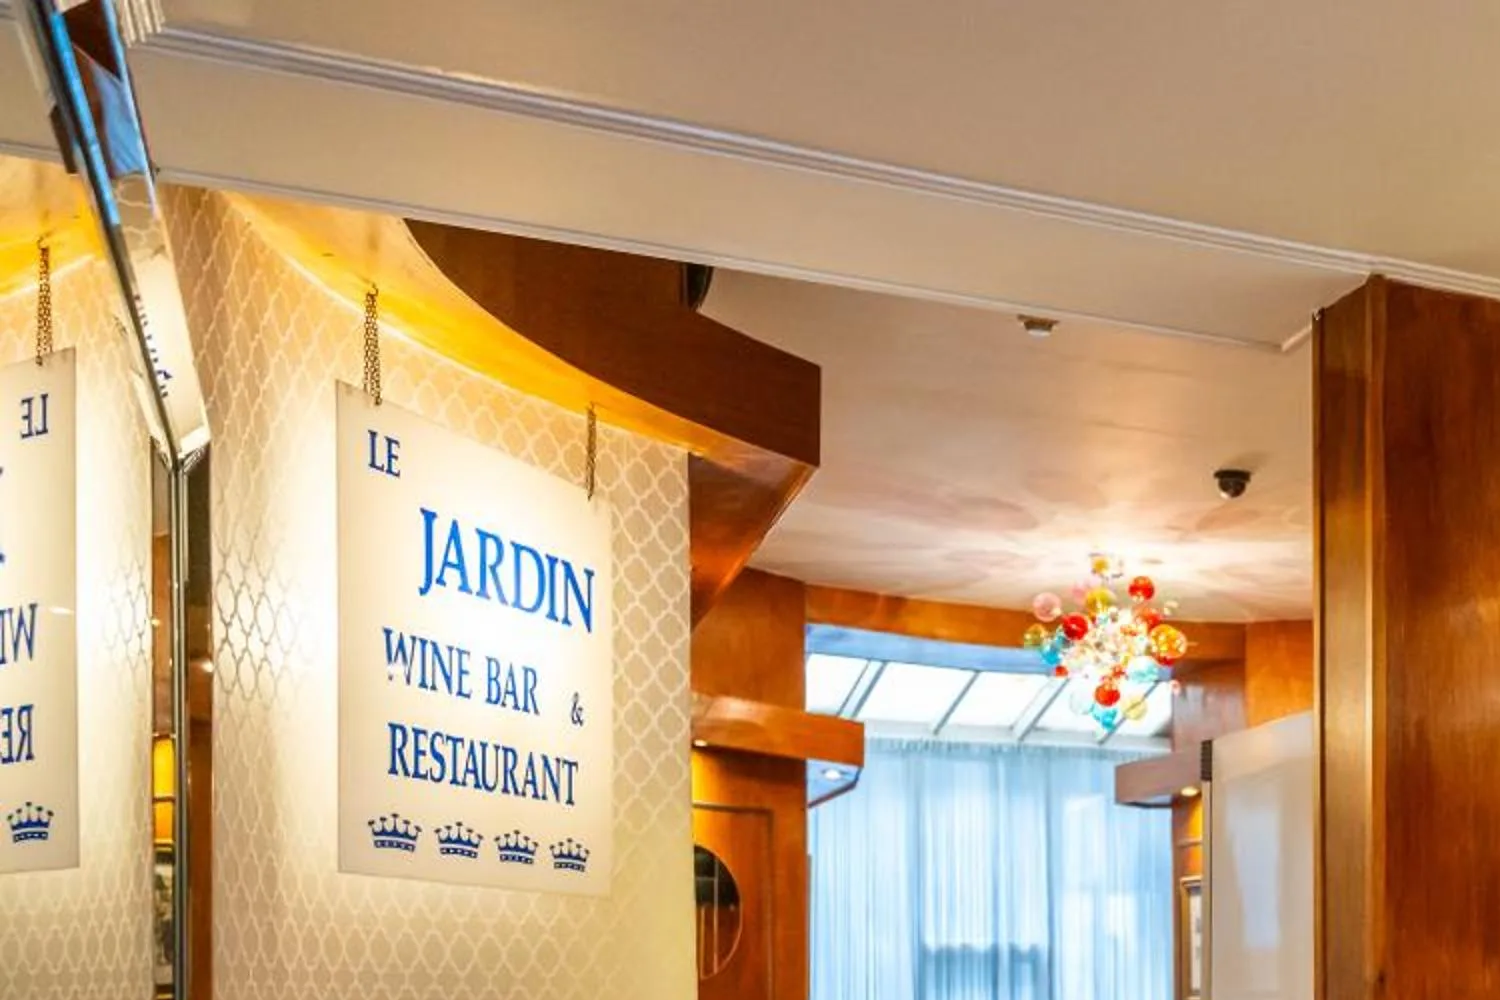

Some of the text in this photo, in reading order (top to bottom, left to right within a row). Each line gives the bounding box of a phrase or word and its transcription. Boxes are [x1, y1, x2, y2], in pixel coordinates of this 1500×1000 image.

[367, 429, 401, 478] LE
[418, 507, 595, 633] JARDIN
[383, 627, 584, 727] WINE BAR &
[387, 722, 579, 806] RESTAURANT
